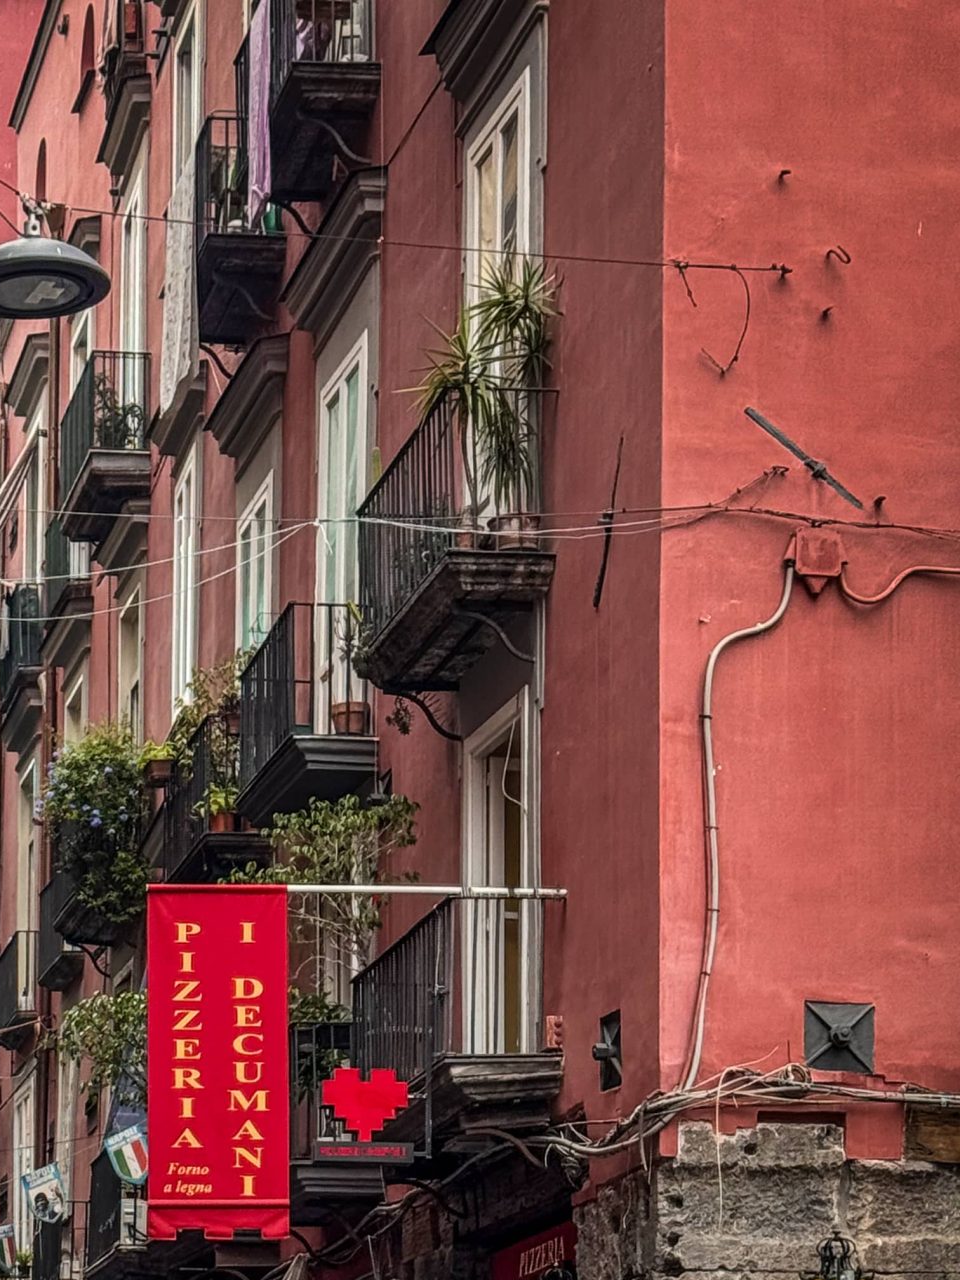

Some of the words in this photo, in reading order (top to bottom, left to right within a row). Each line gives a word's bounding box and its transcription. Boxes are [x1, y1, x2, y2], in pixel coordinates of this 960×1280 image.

[239, 921, 256, 944] I
[171, 921, 205, 1149] PIZZERIA
[227, 977, 271, 1197] DECUMANI
[167, 1162, 210, 1176] Forno
[163, 1184, 172, 1193] a
[176, 1181, 213, 1196] legna
[519, 1236, 565, 1277] PIZZERIA
